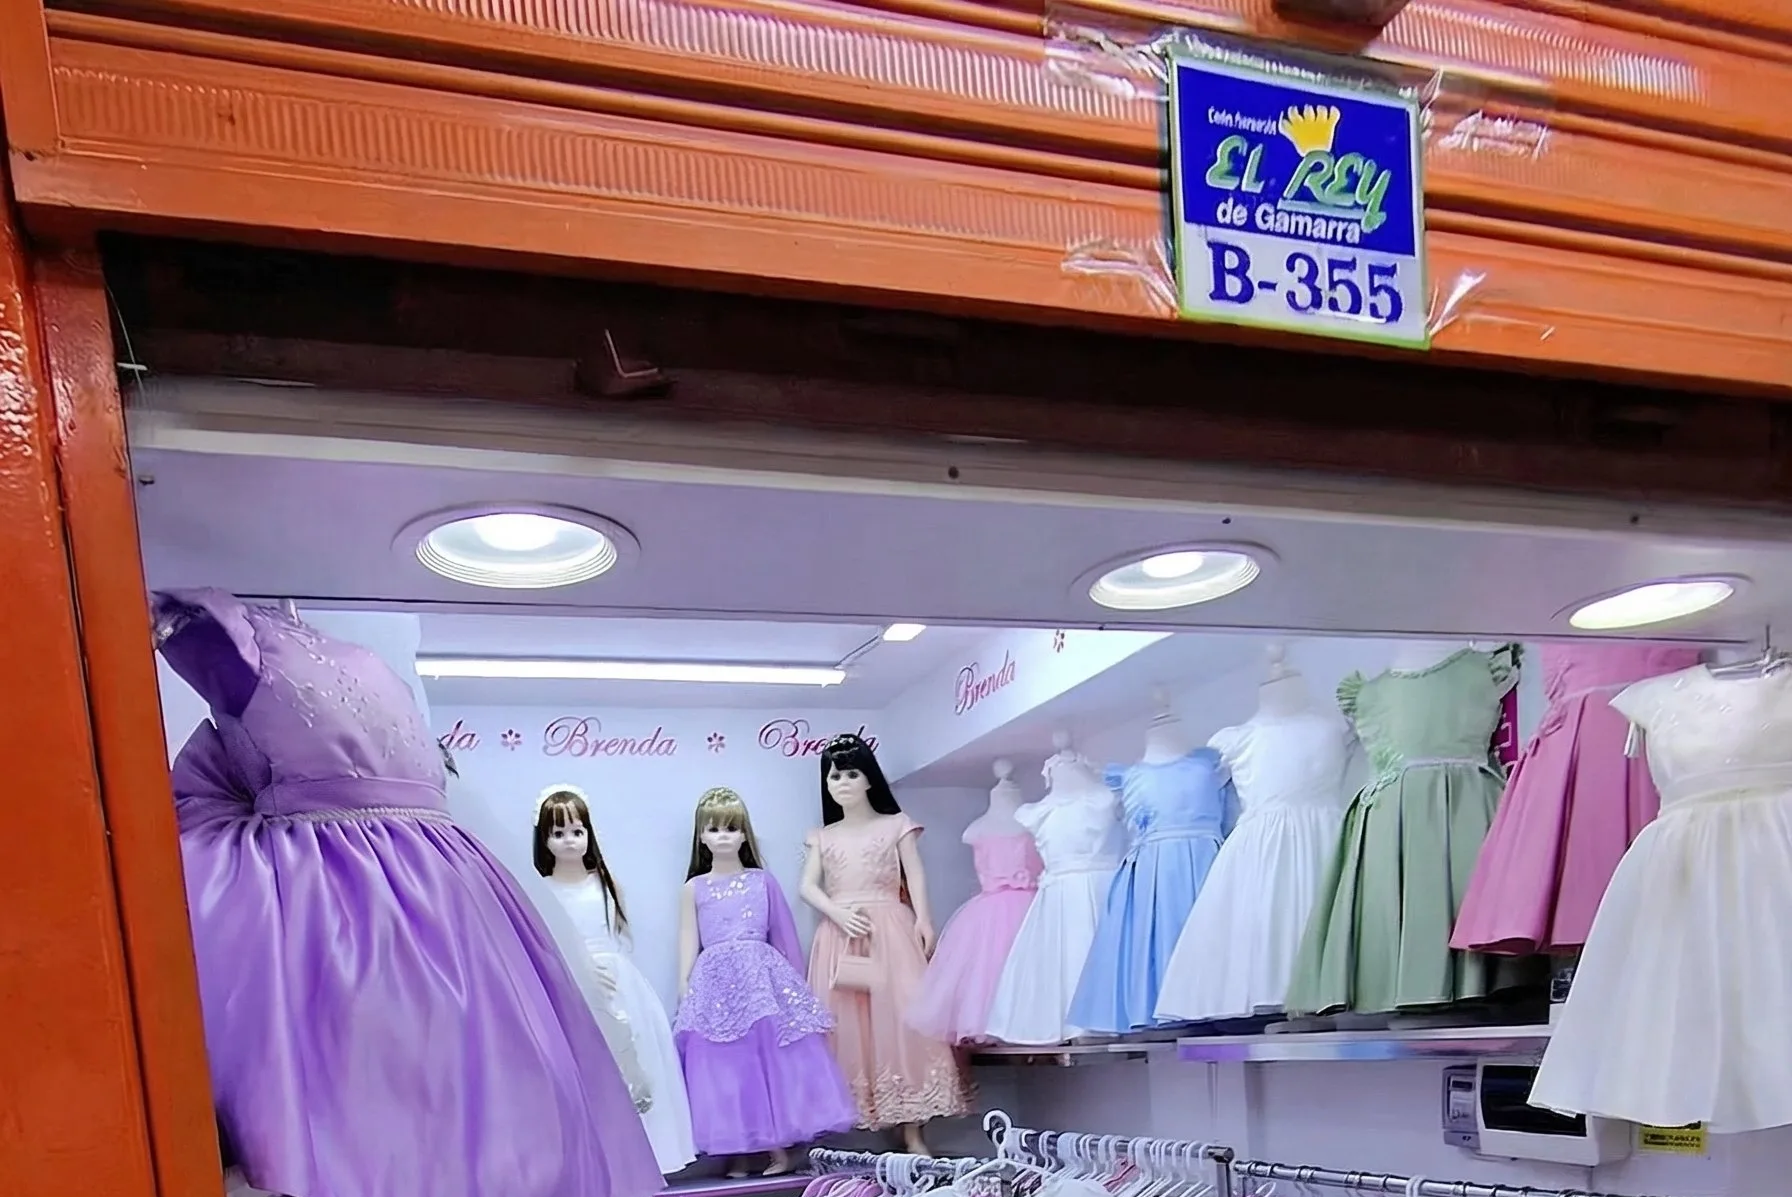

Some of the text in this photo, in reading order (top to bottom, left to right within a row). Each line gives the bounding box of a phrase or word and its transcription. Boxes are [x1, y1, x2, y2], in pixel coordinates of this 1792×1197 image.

[1206, 135, 1392, 233] EL REY
[1216, 197, 1361, 244] de Gamarra
[1207, 241, 1403, 324] B-355
[955, 649, 1016, 716] Brenda
[542, 716, 678, 757] Brenda
